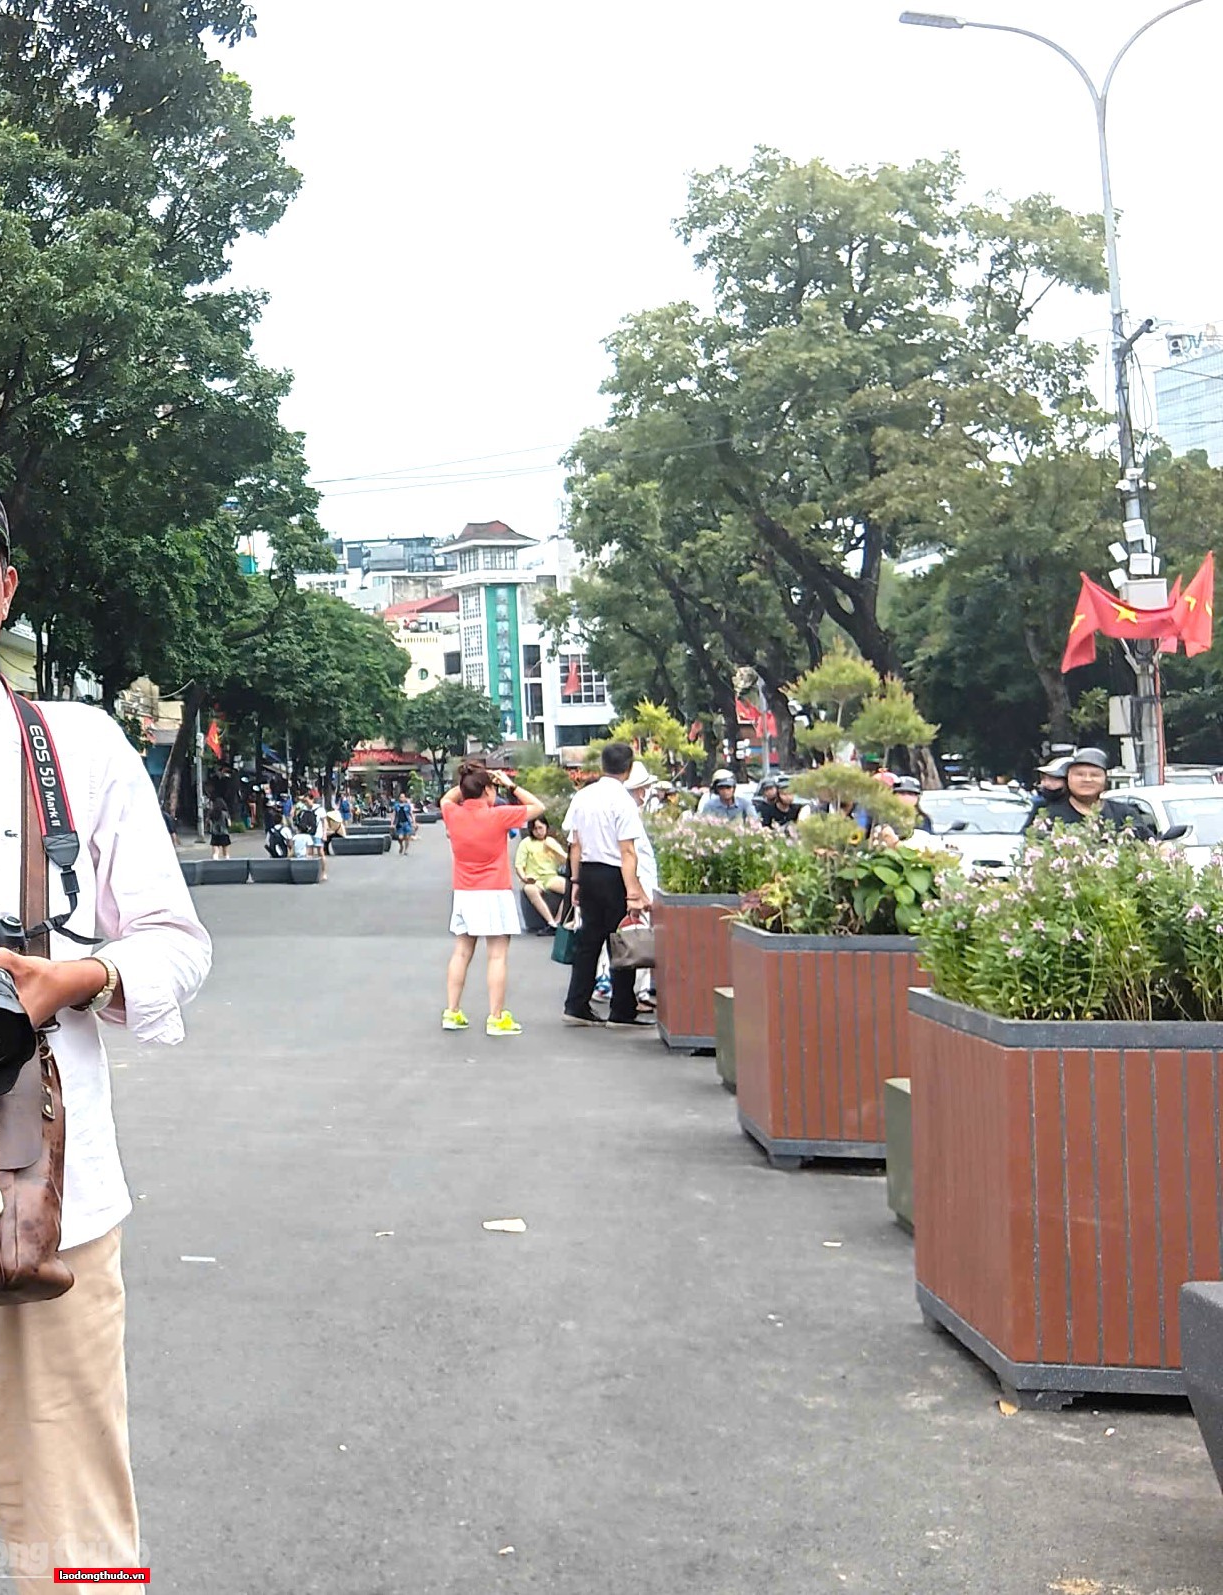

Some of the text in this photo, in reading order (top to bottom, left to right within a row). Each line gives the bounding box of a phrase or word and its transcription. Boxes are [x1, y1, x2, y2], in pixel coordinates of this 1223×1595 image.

[29, 724, 51, 763] EOS
[39, 766, 56, 787] 5D
[45, 791, 61, 819] Mark
